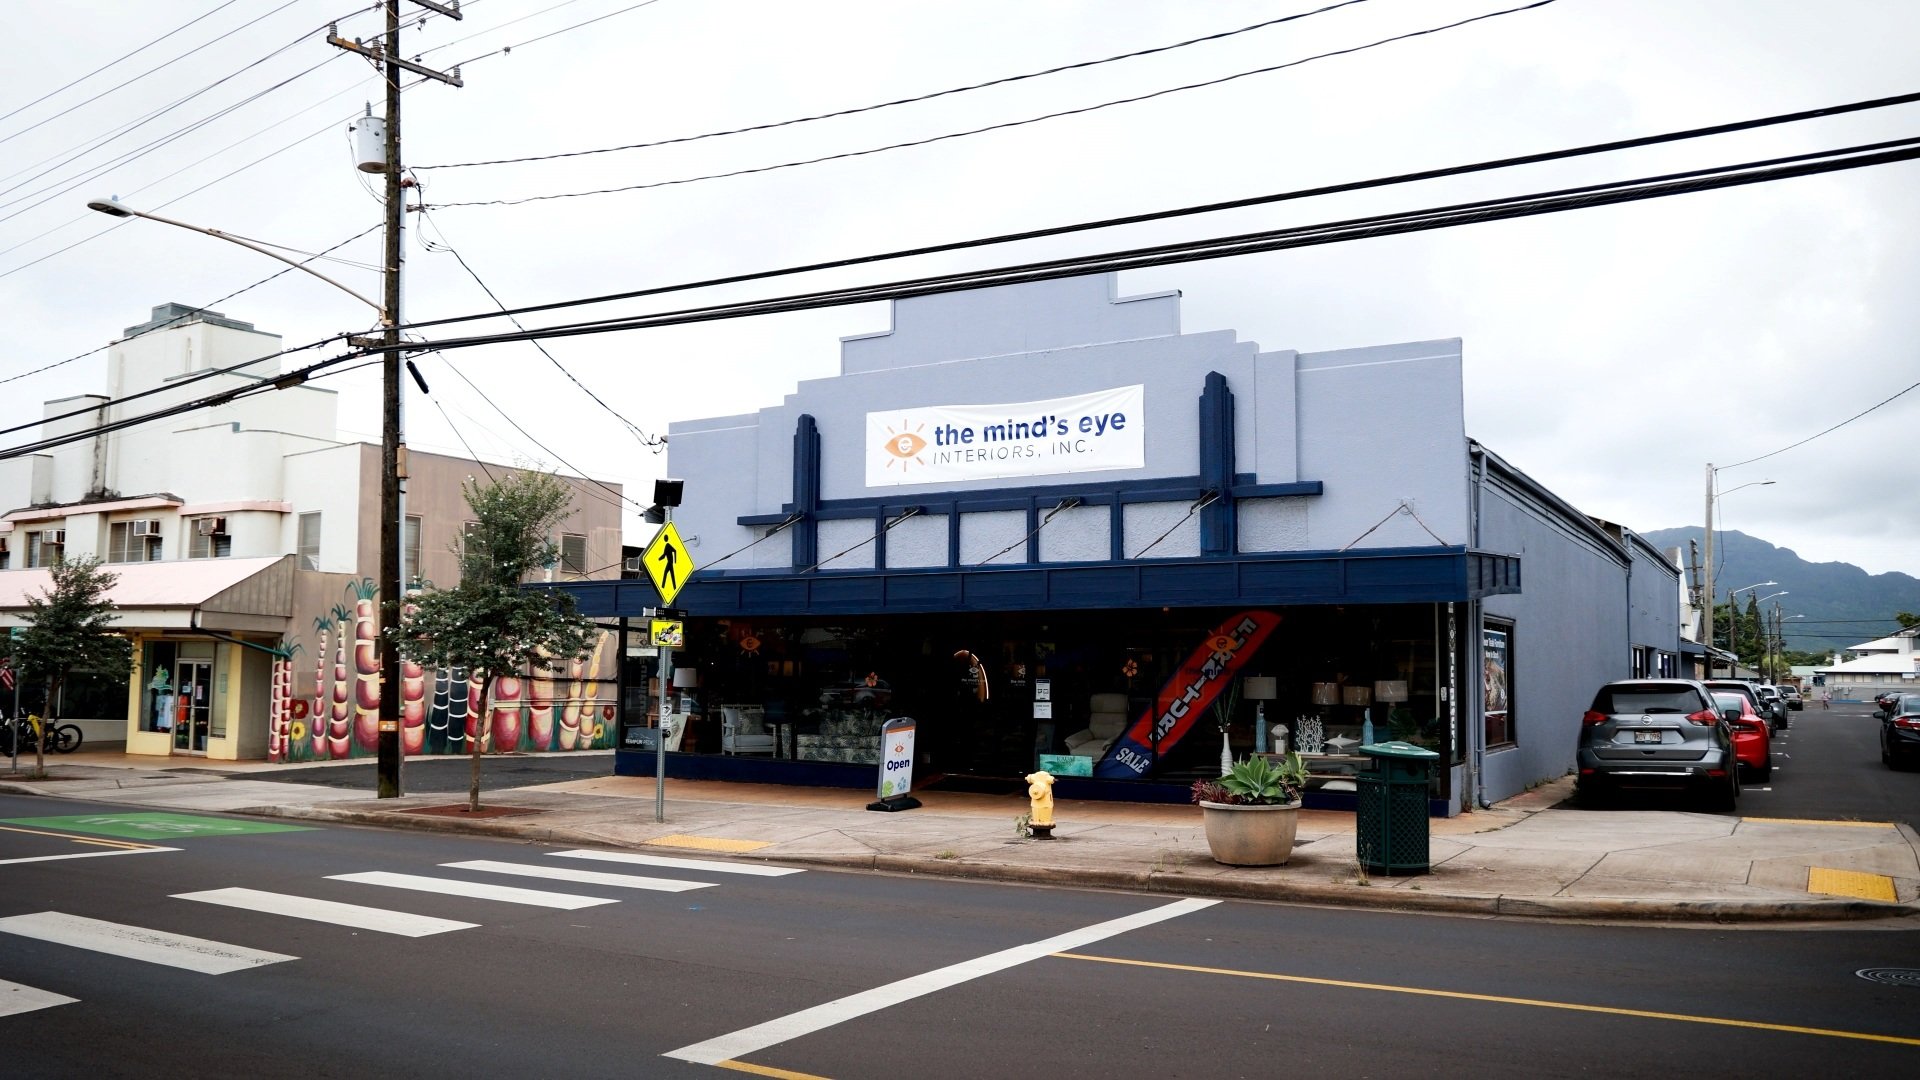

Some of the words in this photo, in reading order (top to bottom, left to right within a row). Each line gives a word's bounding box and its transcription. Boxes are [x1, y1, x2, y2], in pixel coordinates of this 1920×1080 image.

[935, 423, 974, 447] the
[983, 415, 1069, 442] mind's
[1078, 412, 1126, 437] eye
[933, 444, 1042, 465] INTERIORS,
[1052, 439, 1094, 455] INC.
[1148, 617, 1257, 743] FURNITURE
[887, 759, 910, 772] Open
[1115, 747, 1151, 774] SALE
